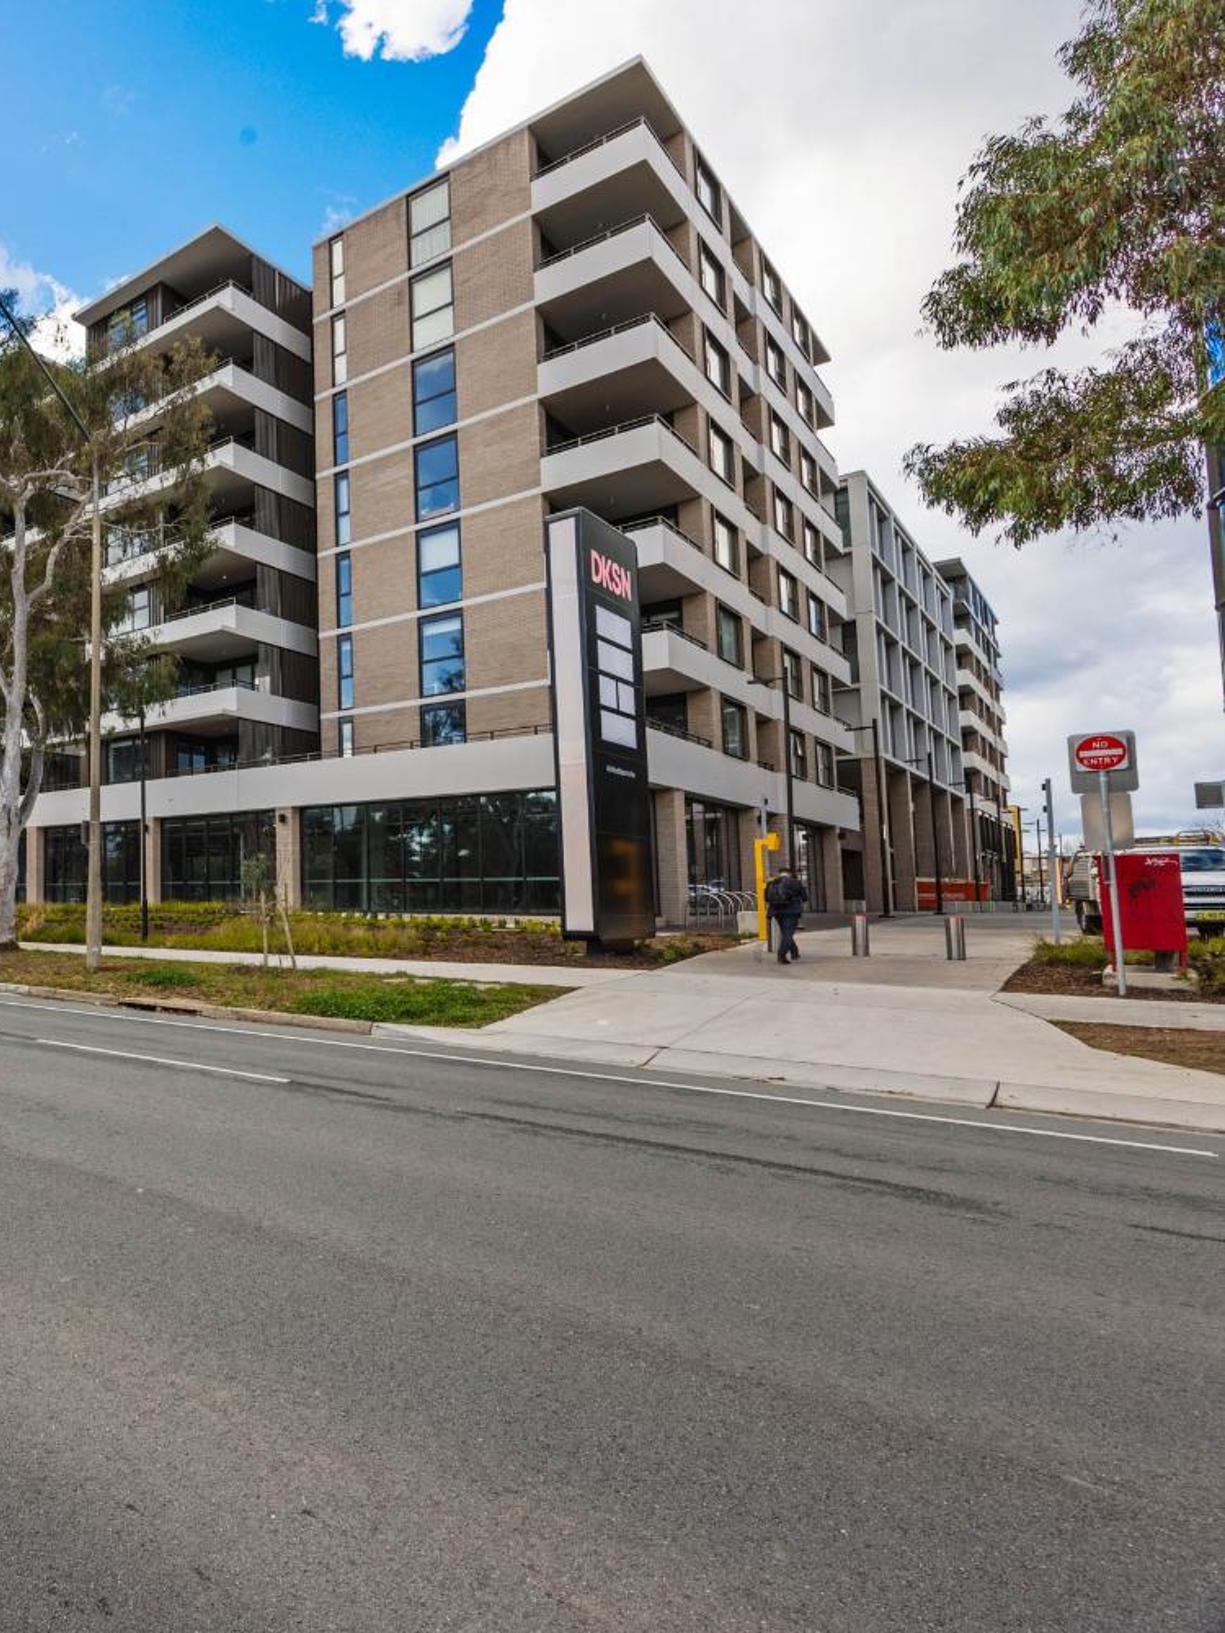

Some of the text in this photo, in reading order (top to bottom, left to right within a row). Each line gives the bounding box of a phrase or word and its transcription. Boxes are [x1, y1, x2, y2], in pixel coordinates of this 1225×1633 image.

[590, 548, 632, 602] DKSN
[1092, 741, 1109, 749] NO
[1083, 756, 1119, 766] ENTRY
